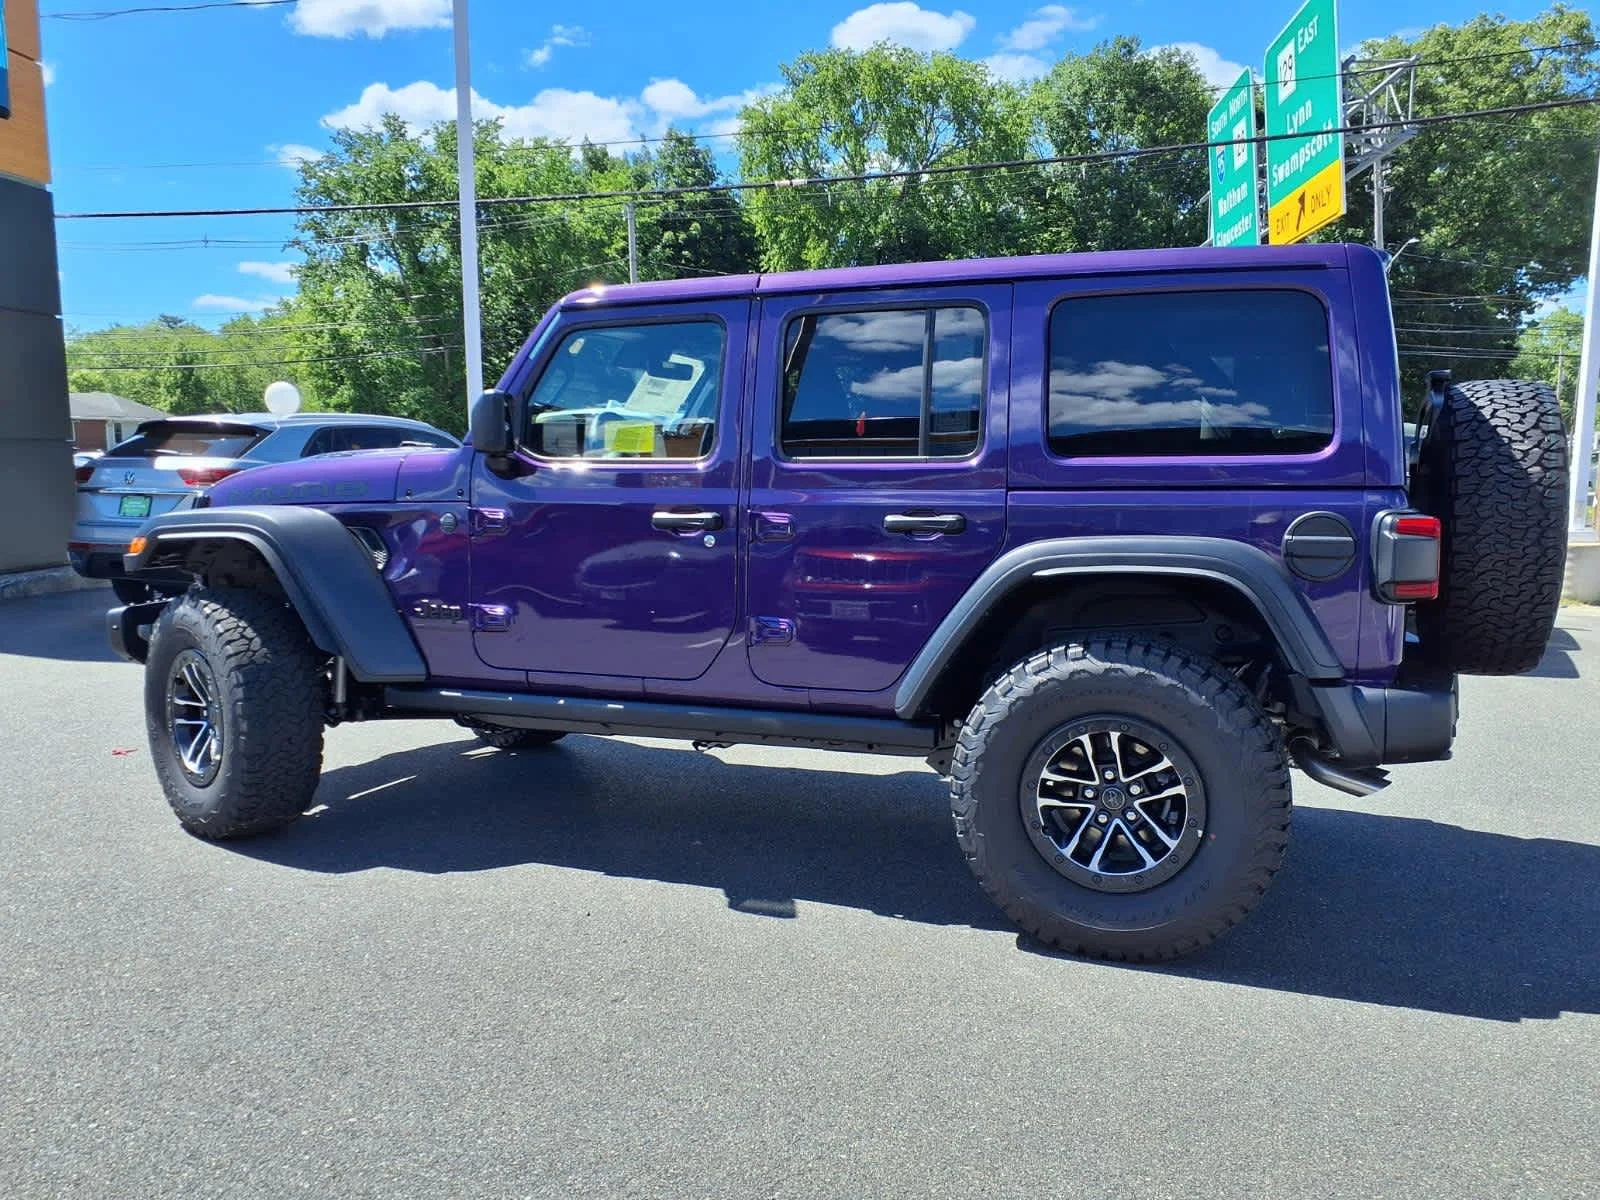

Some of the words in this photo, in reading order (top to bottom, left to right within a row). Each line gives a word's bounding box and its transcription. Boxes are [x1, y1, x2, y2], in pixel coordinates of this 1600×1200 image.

[1297, 14, 1319, 54] EAST
[1229, 86, 1248, 121] NORTH
[1286, 99, 1312, 135] Lynn
[1272, 117, 1333, 188] Swampscott
[1276, 211, 1290, 236] EXIT
[1310, 184, 1332, 214] ONLY
